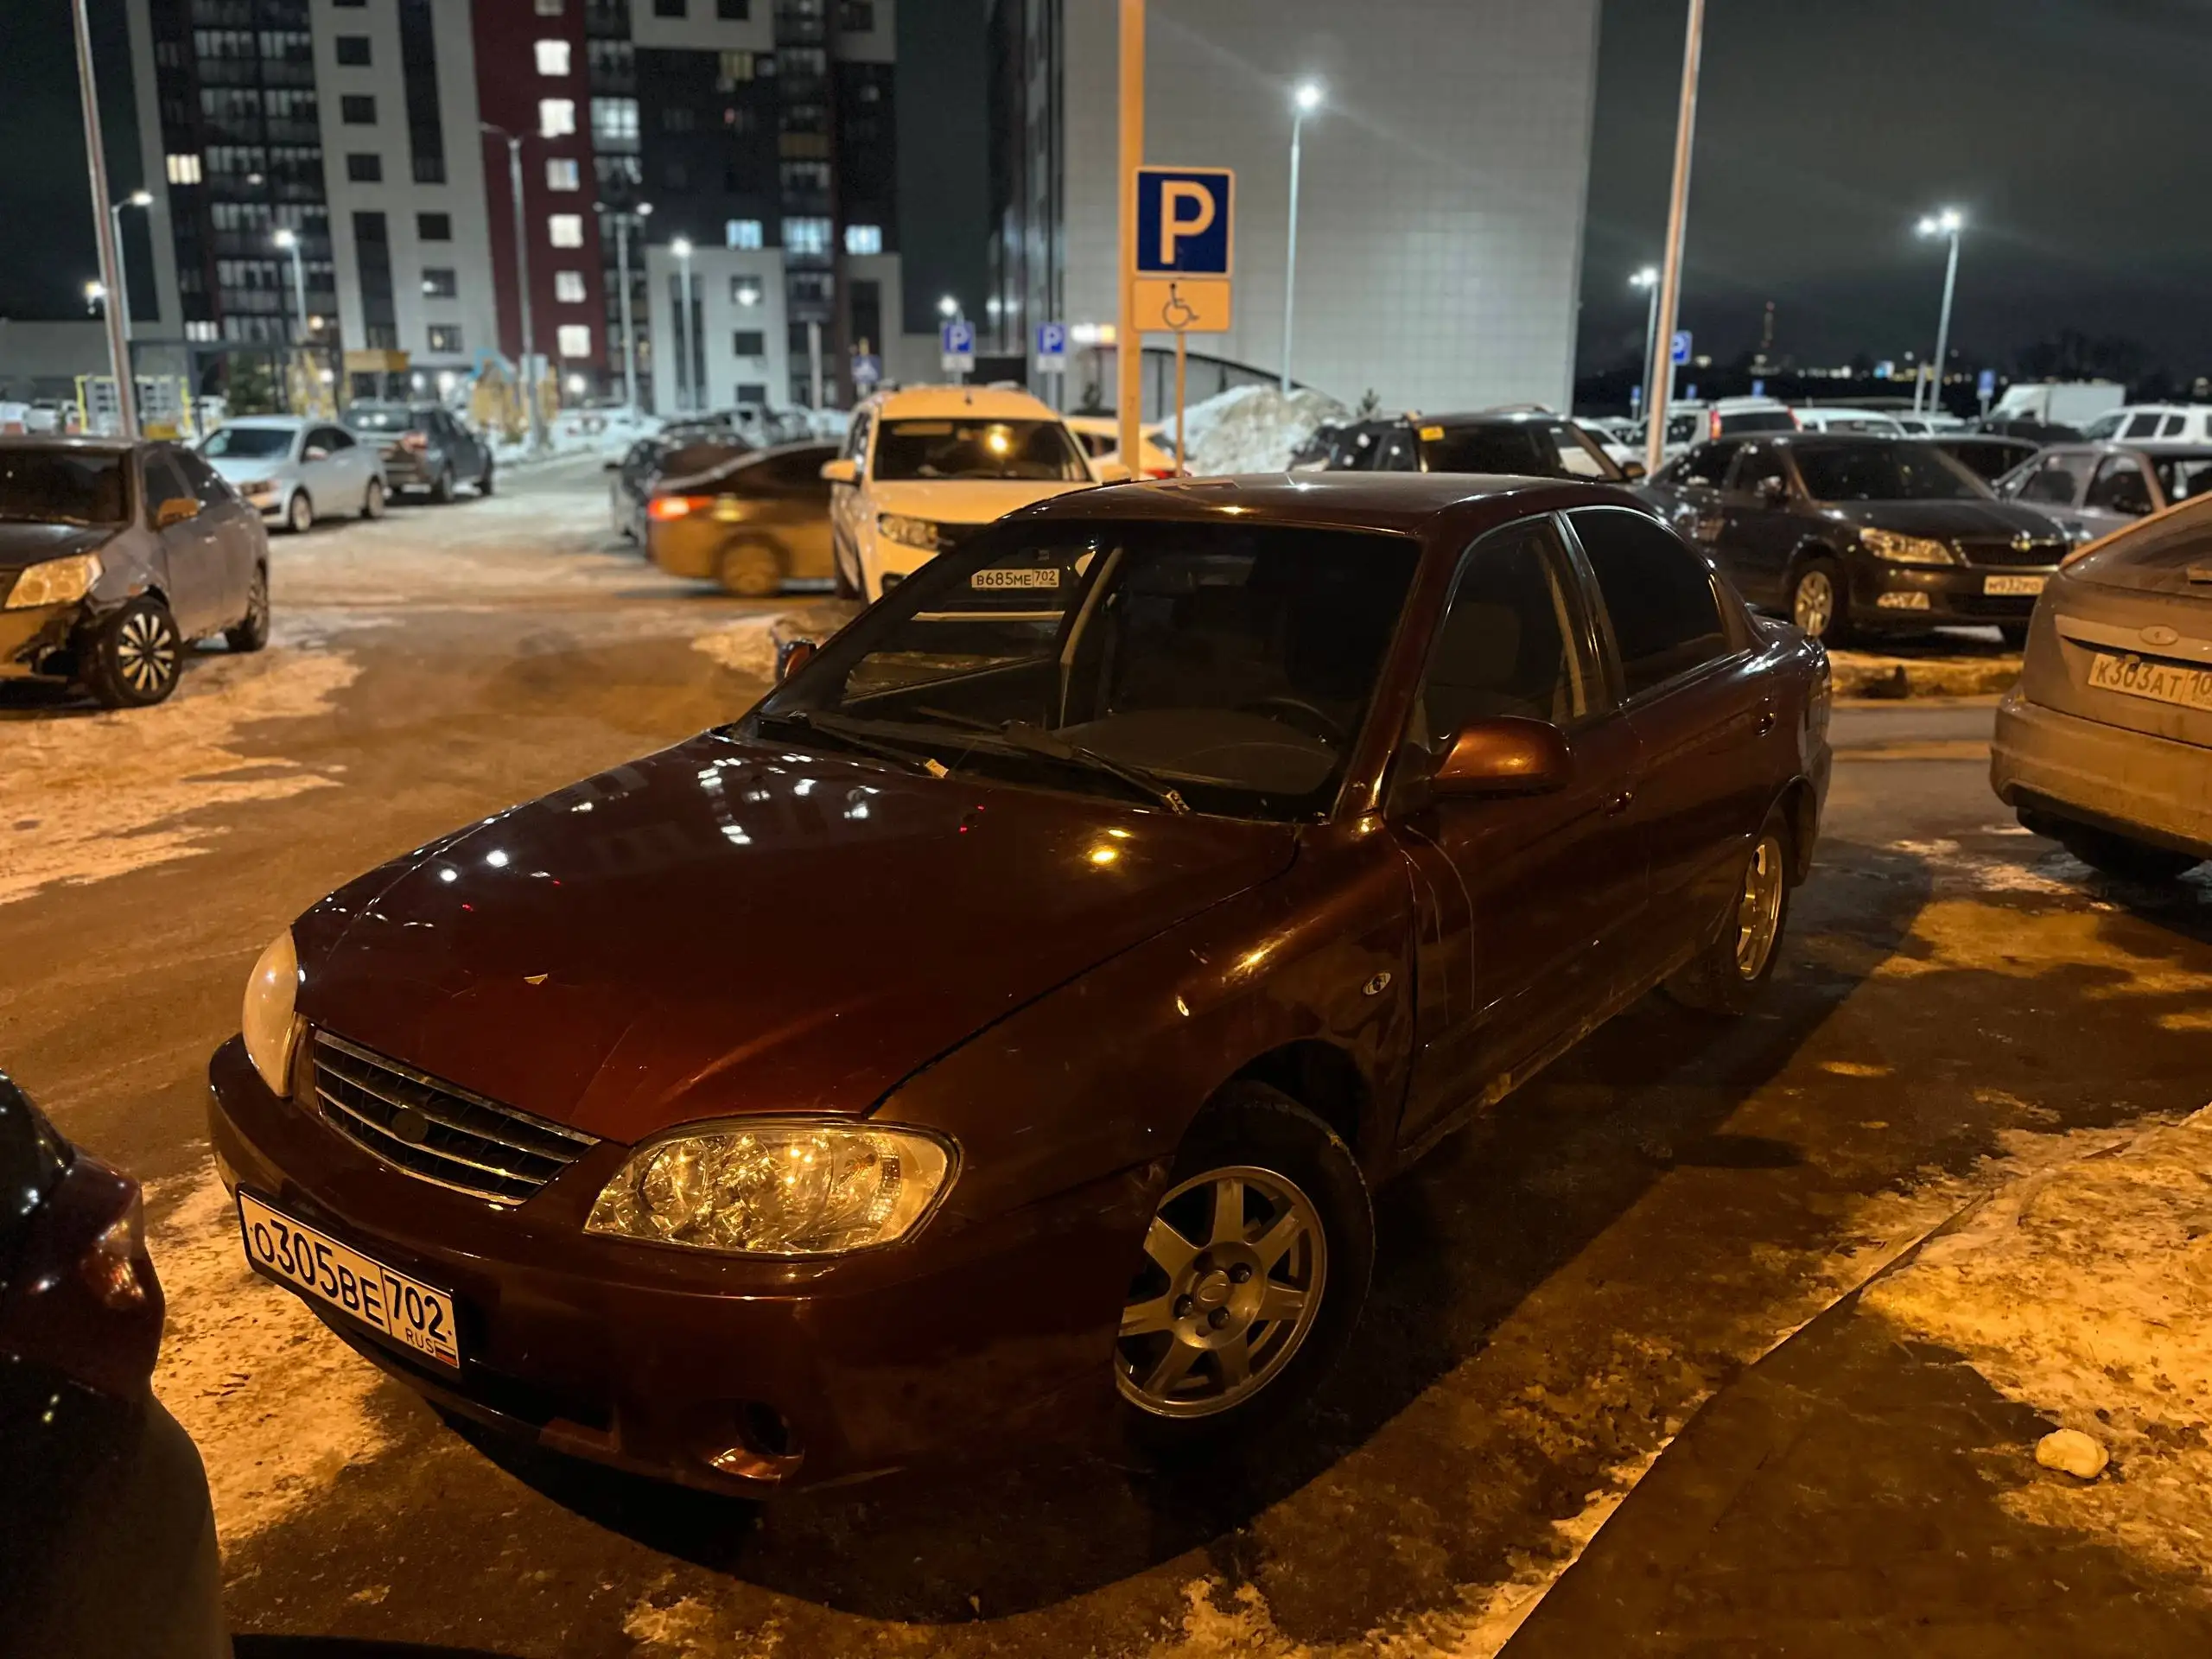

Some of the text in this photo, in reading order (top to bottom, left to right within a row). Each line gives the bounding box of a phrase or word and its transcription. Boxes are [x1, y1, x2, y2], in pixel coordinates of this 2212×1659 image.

[1160, 179, 1216, 264] P
[950, 325, 969, 352] P
[1043, 325, 1062, 353] P
[976, 570, 1056, 586] В685МЕ 702
[254, 1218, 447, 1342] О305ВЕ 702
[405, 1327, 434, 1353] RUS
